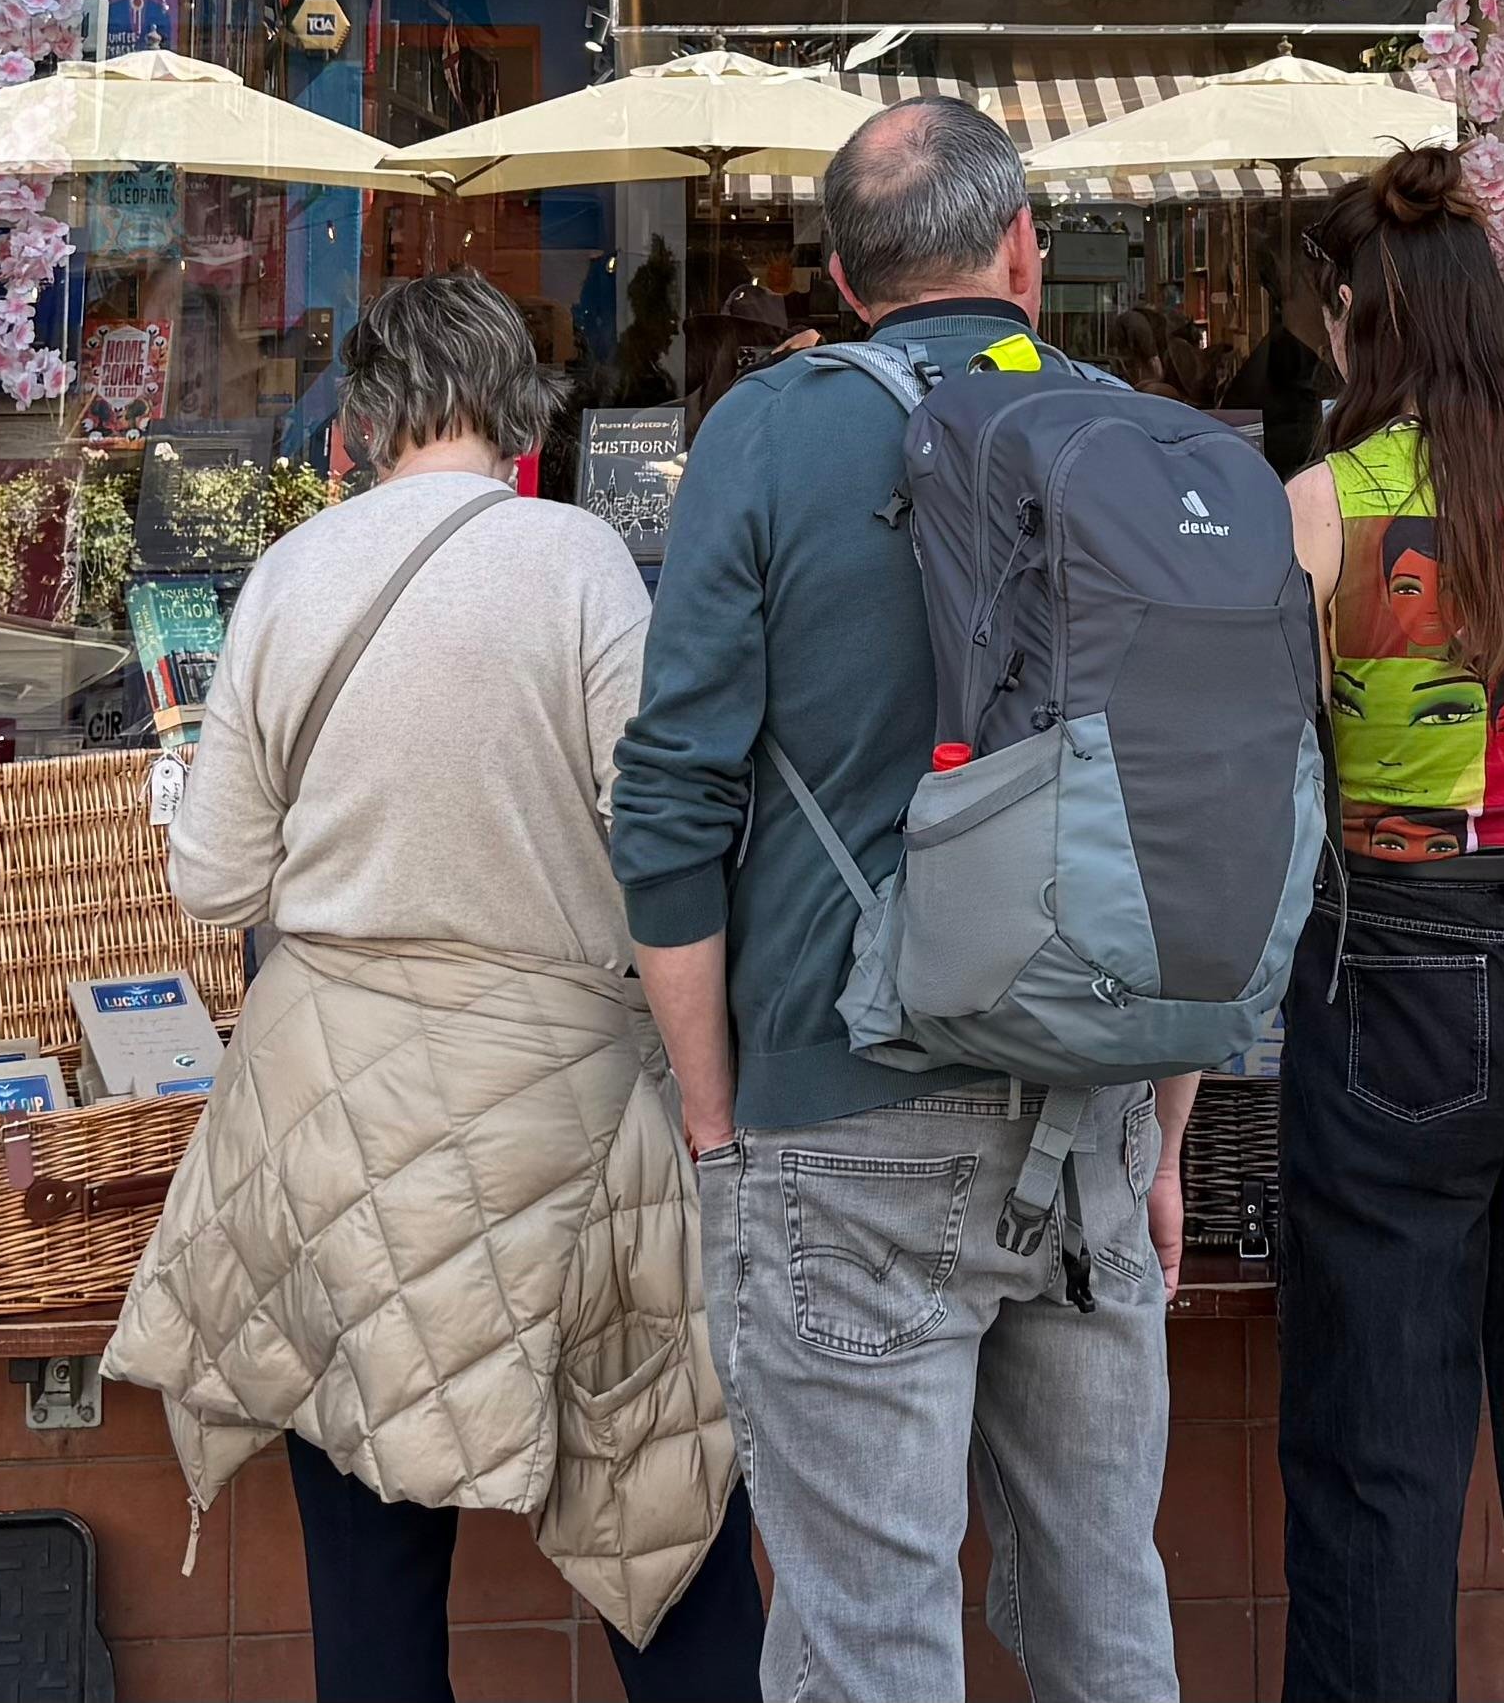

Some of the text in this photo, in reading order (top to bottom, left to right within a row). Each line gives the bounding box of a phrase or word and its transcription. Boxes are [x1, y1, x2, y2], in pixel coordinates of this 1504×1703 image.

[590, 440, 677, 455] MISTBORN
[1179, 520, 1230, 536] deuter
[105, 992, 176, 1007] LUCKY DIP
